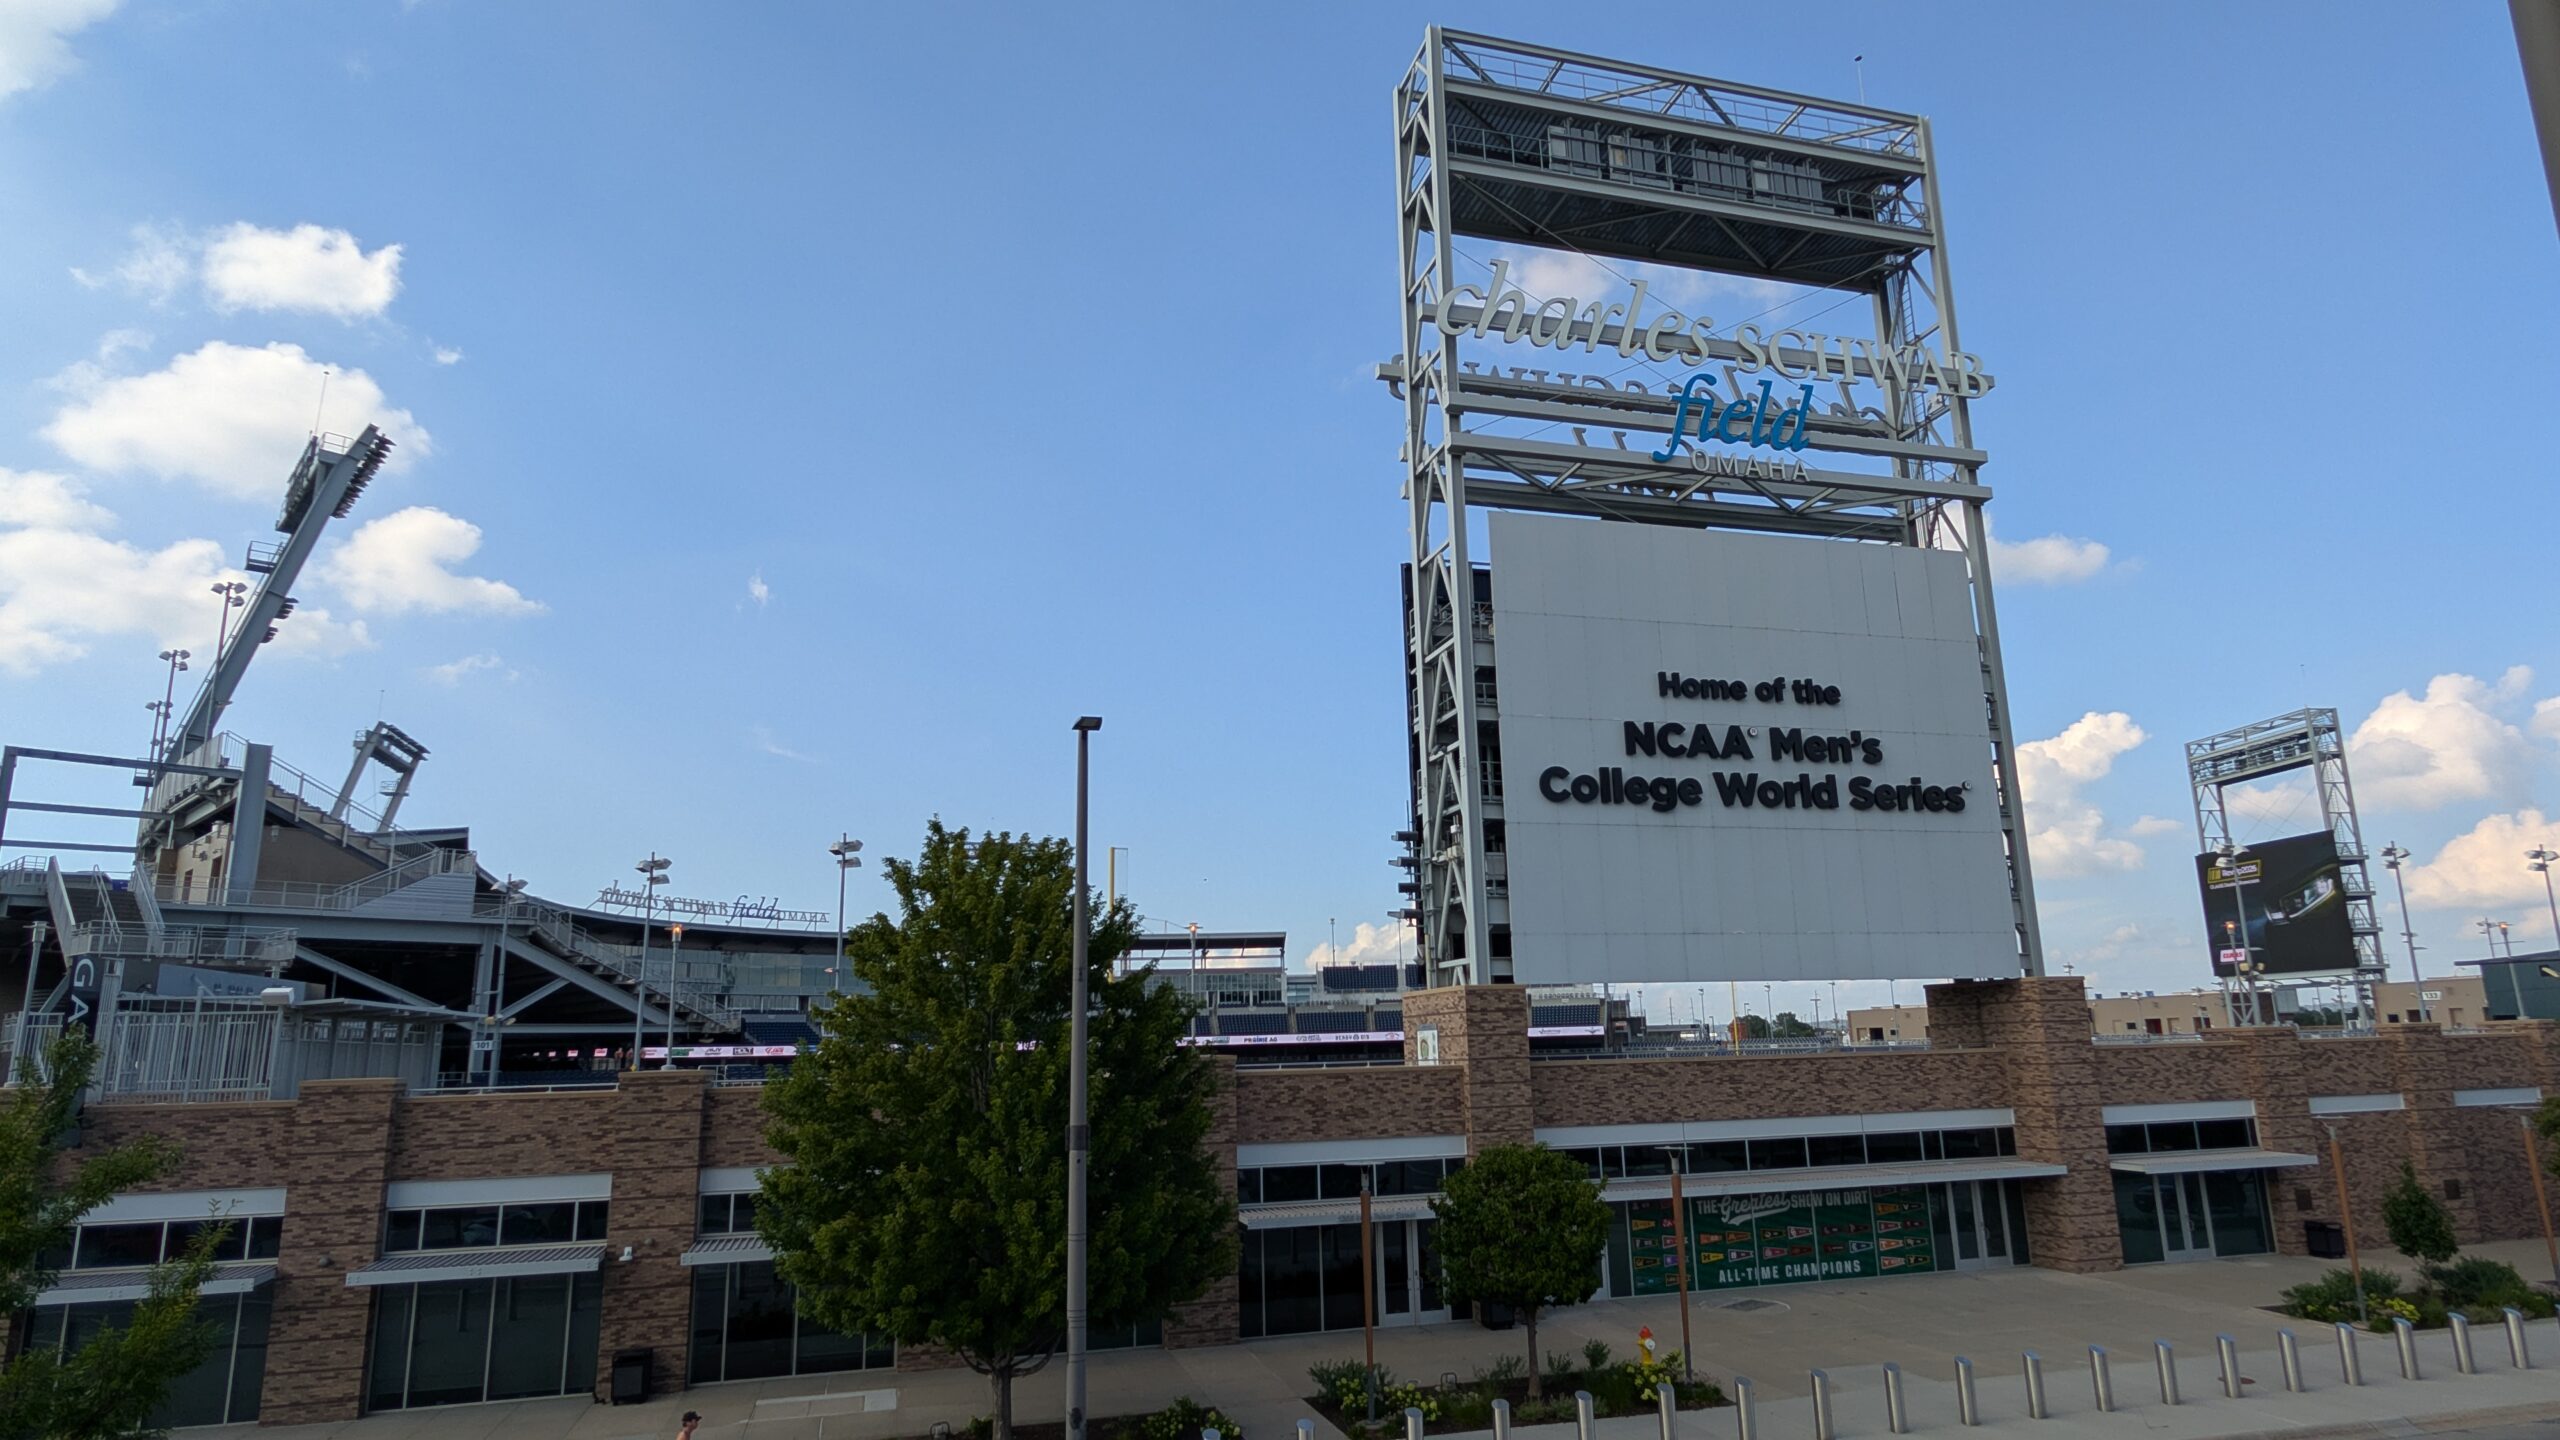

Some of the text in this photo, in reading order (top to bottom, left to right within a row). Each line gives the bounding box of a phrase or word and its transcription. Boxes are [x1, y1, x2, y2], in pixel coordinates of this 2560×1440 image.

[1435, 259, 1992, 399] charles SCHWAB
[1652, 373, 1815, 463] field
[1691, 448, 1812, 482] OMAHA
[1657, 671, 1842, 706] Home of the
[1768, 726, 1884, 765] Men's
[1539, 765, 1704, 813] College
[1712, 770, 1840, 810] World
[664, 894, 728, 916] SCHWAB
[725, 894, 779, 924] field
[1696, 1190, 1869, 1224] THE Greatest SHOW ON DIRT
[1719, 1259, 1862, 1283] ALL-TIME CHAMPIONS
